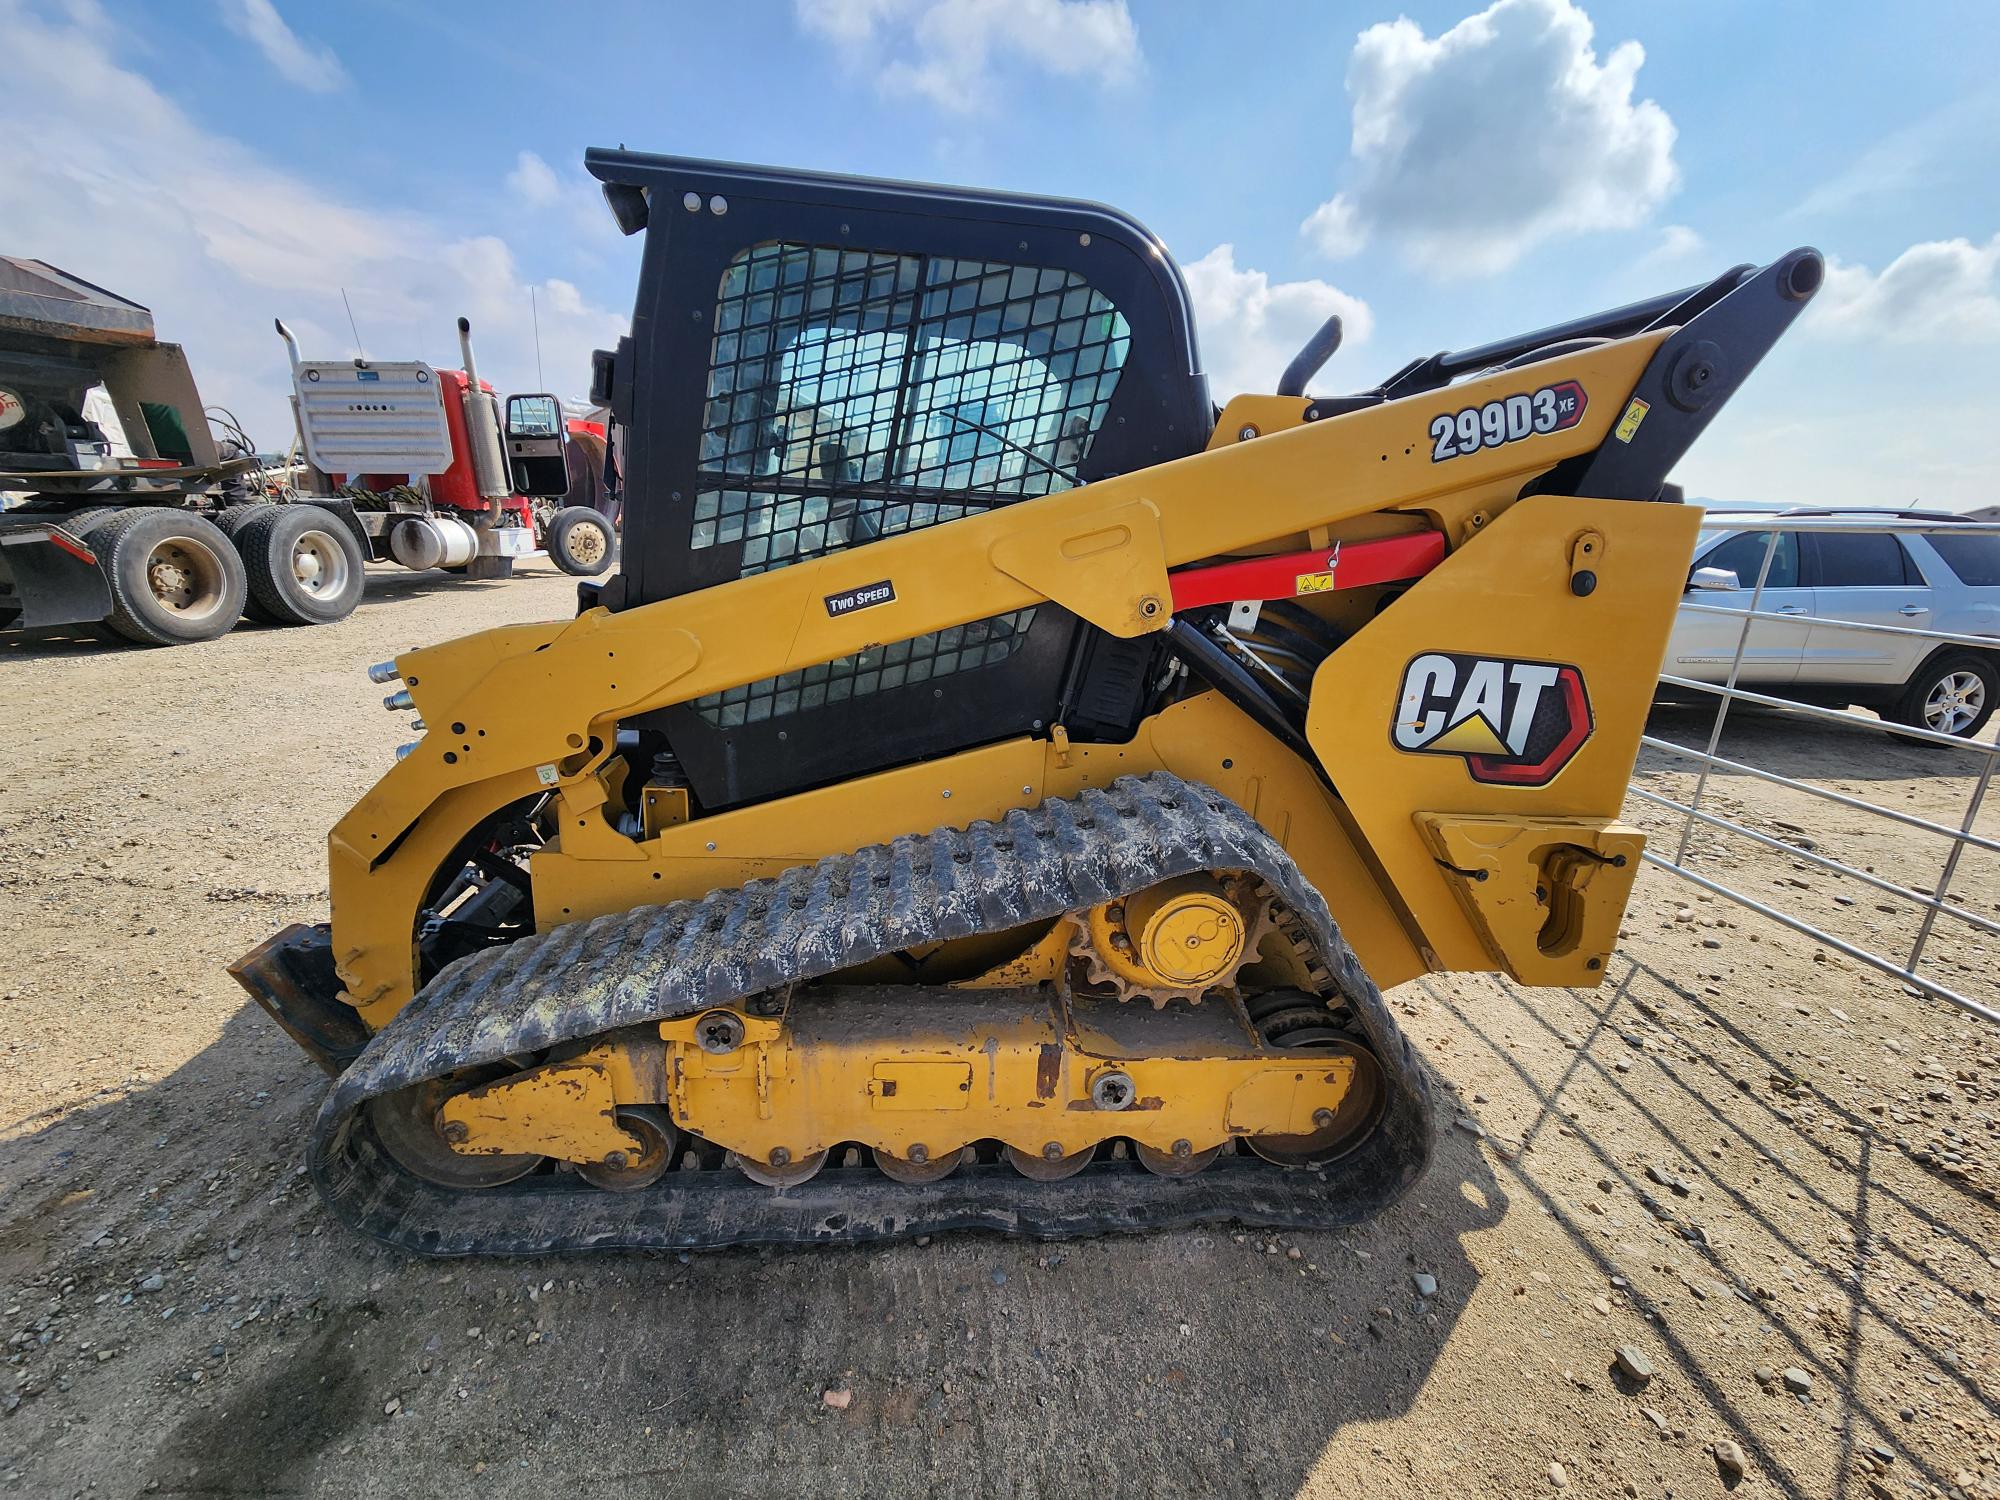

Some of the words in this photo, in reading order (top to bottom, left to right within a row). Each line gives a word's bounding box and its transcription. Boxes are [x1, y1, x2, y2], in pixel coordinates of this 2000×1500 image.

[1430, 388, 1557, 461] 299D3
[1558, 397, 1576, 413] XE
[830, 596, 854, 612] TWO
[856, 586, 890, 605] SPEED
[1395, 654, 1560, 756] CAT
